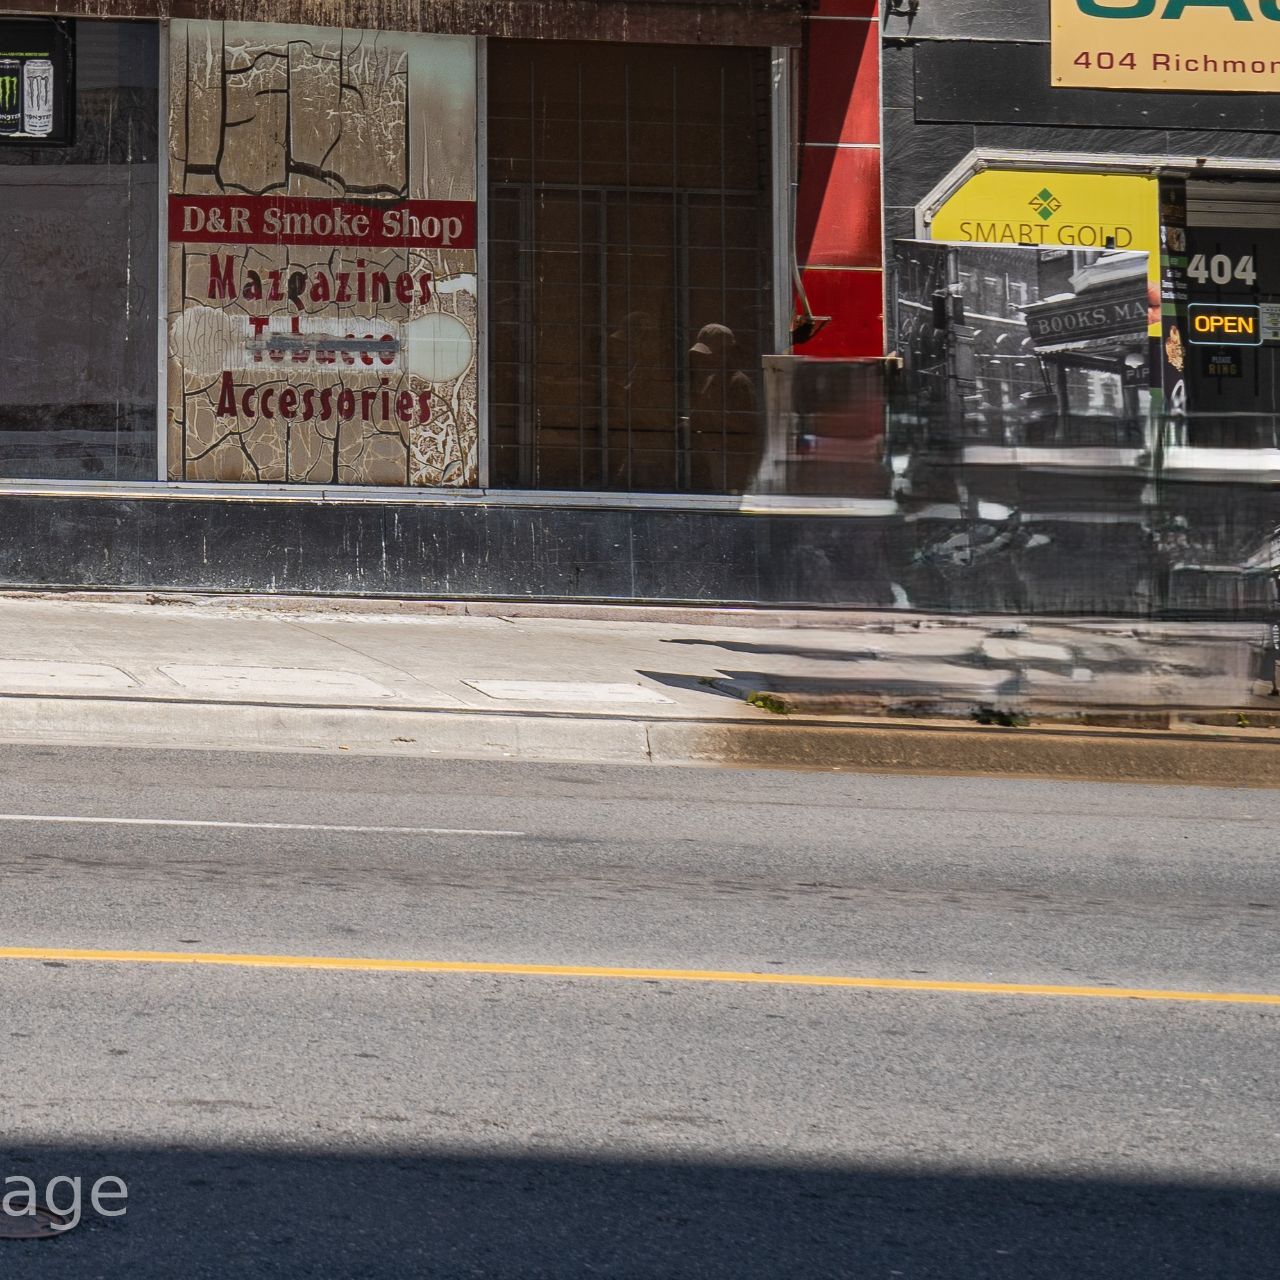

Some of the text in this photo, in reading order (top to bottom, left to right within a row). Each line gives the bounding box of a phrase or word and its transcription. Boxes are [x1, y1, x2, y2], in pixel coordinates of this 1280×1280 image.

[1073, 51, 1137, 71] 404
[182, 205, 464, 246] D&R Smoke Shop
[959, 222, 1133, 248] SMART GOLD
[208, 253, 433, 311] Mazgazines
[1187, 254, 1257, 286] 404
[1194, 314, 1255, 334] OPEN
[1208, 364, 1237, 375] RING
[216, 371, 432, 424] Accessories
